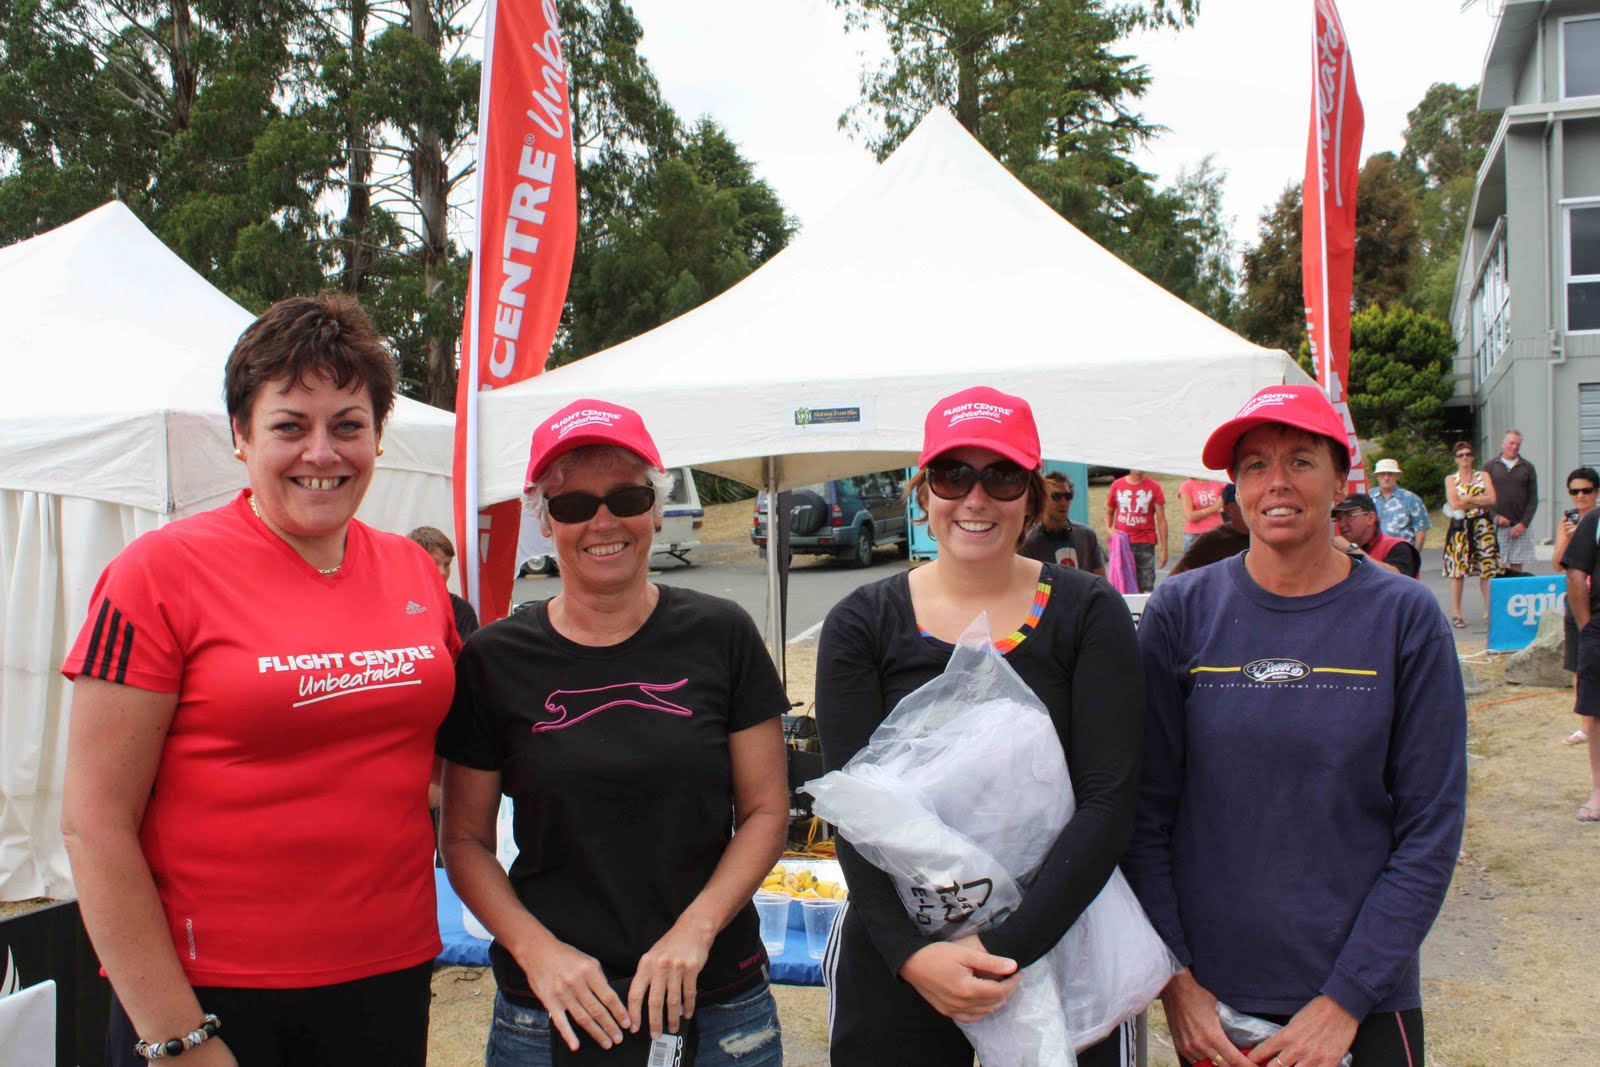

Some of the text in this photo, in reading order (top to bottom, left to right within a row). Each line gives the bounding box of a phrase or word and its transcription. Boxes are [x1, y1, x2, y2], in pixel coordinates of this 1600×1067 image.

[943, 403, 973, 417] FLIGHT
[551, 411, 581, 431] FLIGHT
[257, 653, 345, 673] FLIGHT
[1246, 660, 1304, 681] Cheers
[298, 660, 416, 697] Unbeatable
[1220, 682, 1271, 690] everybody
